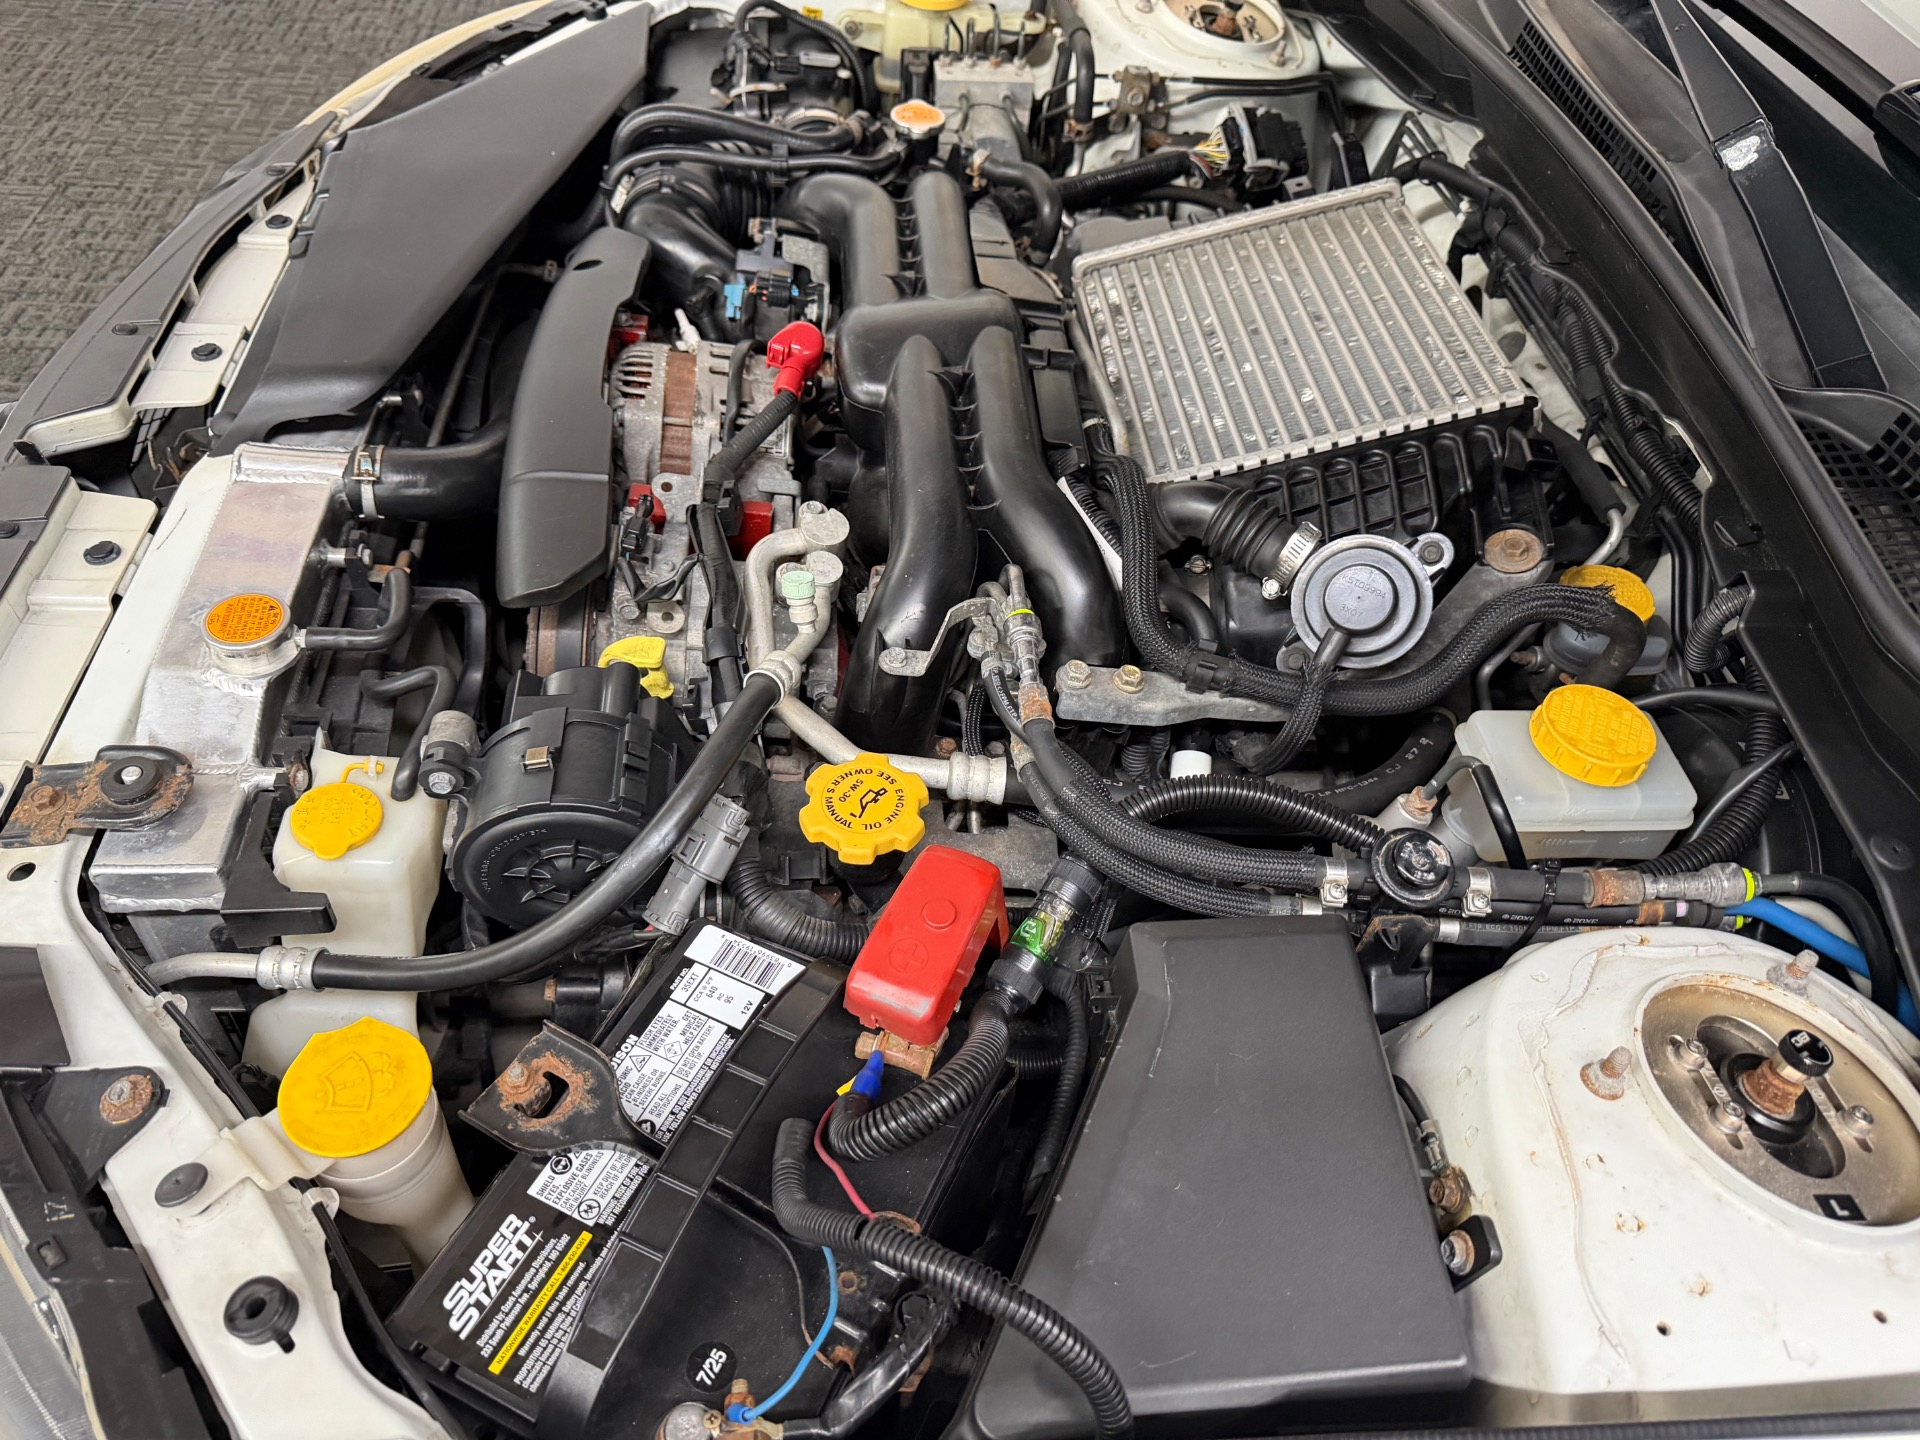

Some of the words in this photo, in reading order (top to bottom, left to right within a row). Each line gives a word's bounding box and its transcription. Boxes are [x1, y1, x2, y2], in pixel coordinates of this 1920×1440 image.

[877, 770, 897, 785] SEE
[838, 778, 864, 803] 5W-30
[825, 796, 853, 829] MANUAL
[884, 788, 904, 824] ENGINE
[861, 821, 882, 830] OIL
[669, 975, 682, 990] PART
[680, 971, 699, 992] 35EXT
[704, 985, 718, 998] 640
[723, 994, 734, 1004] 95
[740, 999, 753, 1015] 12V
[679, 1013, 699, 1037] MEDICAL
[681, 1009, 693, 1021] GET
[637, 1027, 654, 1046] FLUSH
[650, 1014, 664, 1029] EYES
[644, 1013, 673, 1049] IMMEDIATELY
[681, 1030, 695, 1046] HELP
[651, 1036, 666, 1052] WITH
[687, 1044, 700, 1058] OPEN
[676, 1066, 685, 1075] DO
[680, 1056, 691, 1068] NOT
[682, 1069, 691, 1078] DO
[686, 1058, 698, 1071] NOT
[624, 1087, 636, 1099] CAN
[632, 1072, 647, 1089] CAUSE
[631, 1075, 654, 1103] BLINDNESS
[650, 1067, 659, 1077] OR
[637, 1086, 655, 1106] SEVERE
[647, 1101, 661, 1116] READ
[657, 1092, 668, 1102] ALL
[668, 1110, 686, 1131] FOLLOW
[681, 1091, 698, 1112] PROPER
[693, 1068, 714, 1093] CHARGING
[535, 1174, 555, 1197] SHIELD
[551, 1171, 579, 1205] EXPLOSIVE
[574, 1151, 593, 1172] GASES
[559, 1195, 571, 1209] CAN
[567, 1178, 584, 1197] CAUSE
[579, 1150, 604, 1180] BLINDNESS
[591, 1181, 604, 1196] KEEP
[600, 1170, 613, 1183] OUT
[608, 1162, 618, 1172] OF
[598, 1180, 615, 1199] REACH
[610, 1172, 620, 1182] OF
[543, 1183, 561, 1201] EYES.
[596, 1198, 618, 1224] WARNING:
[614, 1184, 627, 1198] RISK
[622, 1176, 632, 1186] OF
[604, 1212, 617, 1226] NOT
[612, 1174, 642, 1214] RECOMMENDED
[565, 1201, 575, 1212] OR
[1829, 1199, 1850, 1216] L
[443, 1214, 522, 1315] SUPER
[449, 1221, 536, 1338] START
[500, 1295, 516, 1312] Ozark
[511, 1266, 536, 1297] Automotive
[480, 1343, 493, 1357] 233
[487, 1327, 504, 1346] South
[547, 1248, 559, 1261] MO
[517, 1328, 540, 1356] Warranty
[535, 1315, 549, 1330] void
[547, 1299, 559, 1312] this
[554, 1285, 569, 1301] label
[565, 1261, 586, 1287] removed.
[495, 1325, 525, 1365] NATIONWIDE
[522, 1291, 548, 1325] WARRANTY
[545, 1276, 560, 1293] CALL
[513, 1345, 543, 1384] PROPOSITION
[538, 1337, 548, 1347] 65
[561, 1293, 580, 1313] Battery
[549, 1337, 559, 1345] to
[553, 1328, 564, 1339] the
[537, 1343, 554, 1361] known
[519, 1360, 543, 1388] chemicals
[695, 1347, 728, 1386] 7/25
